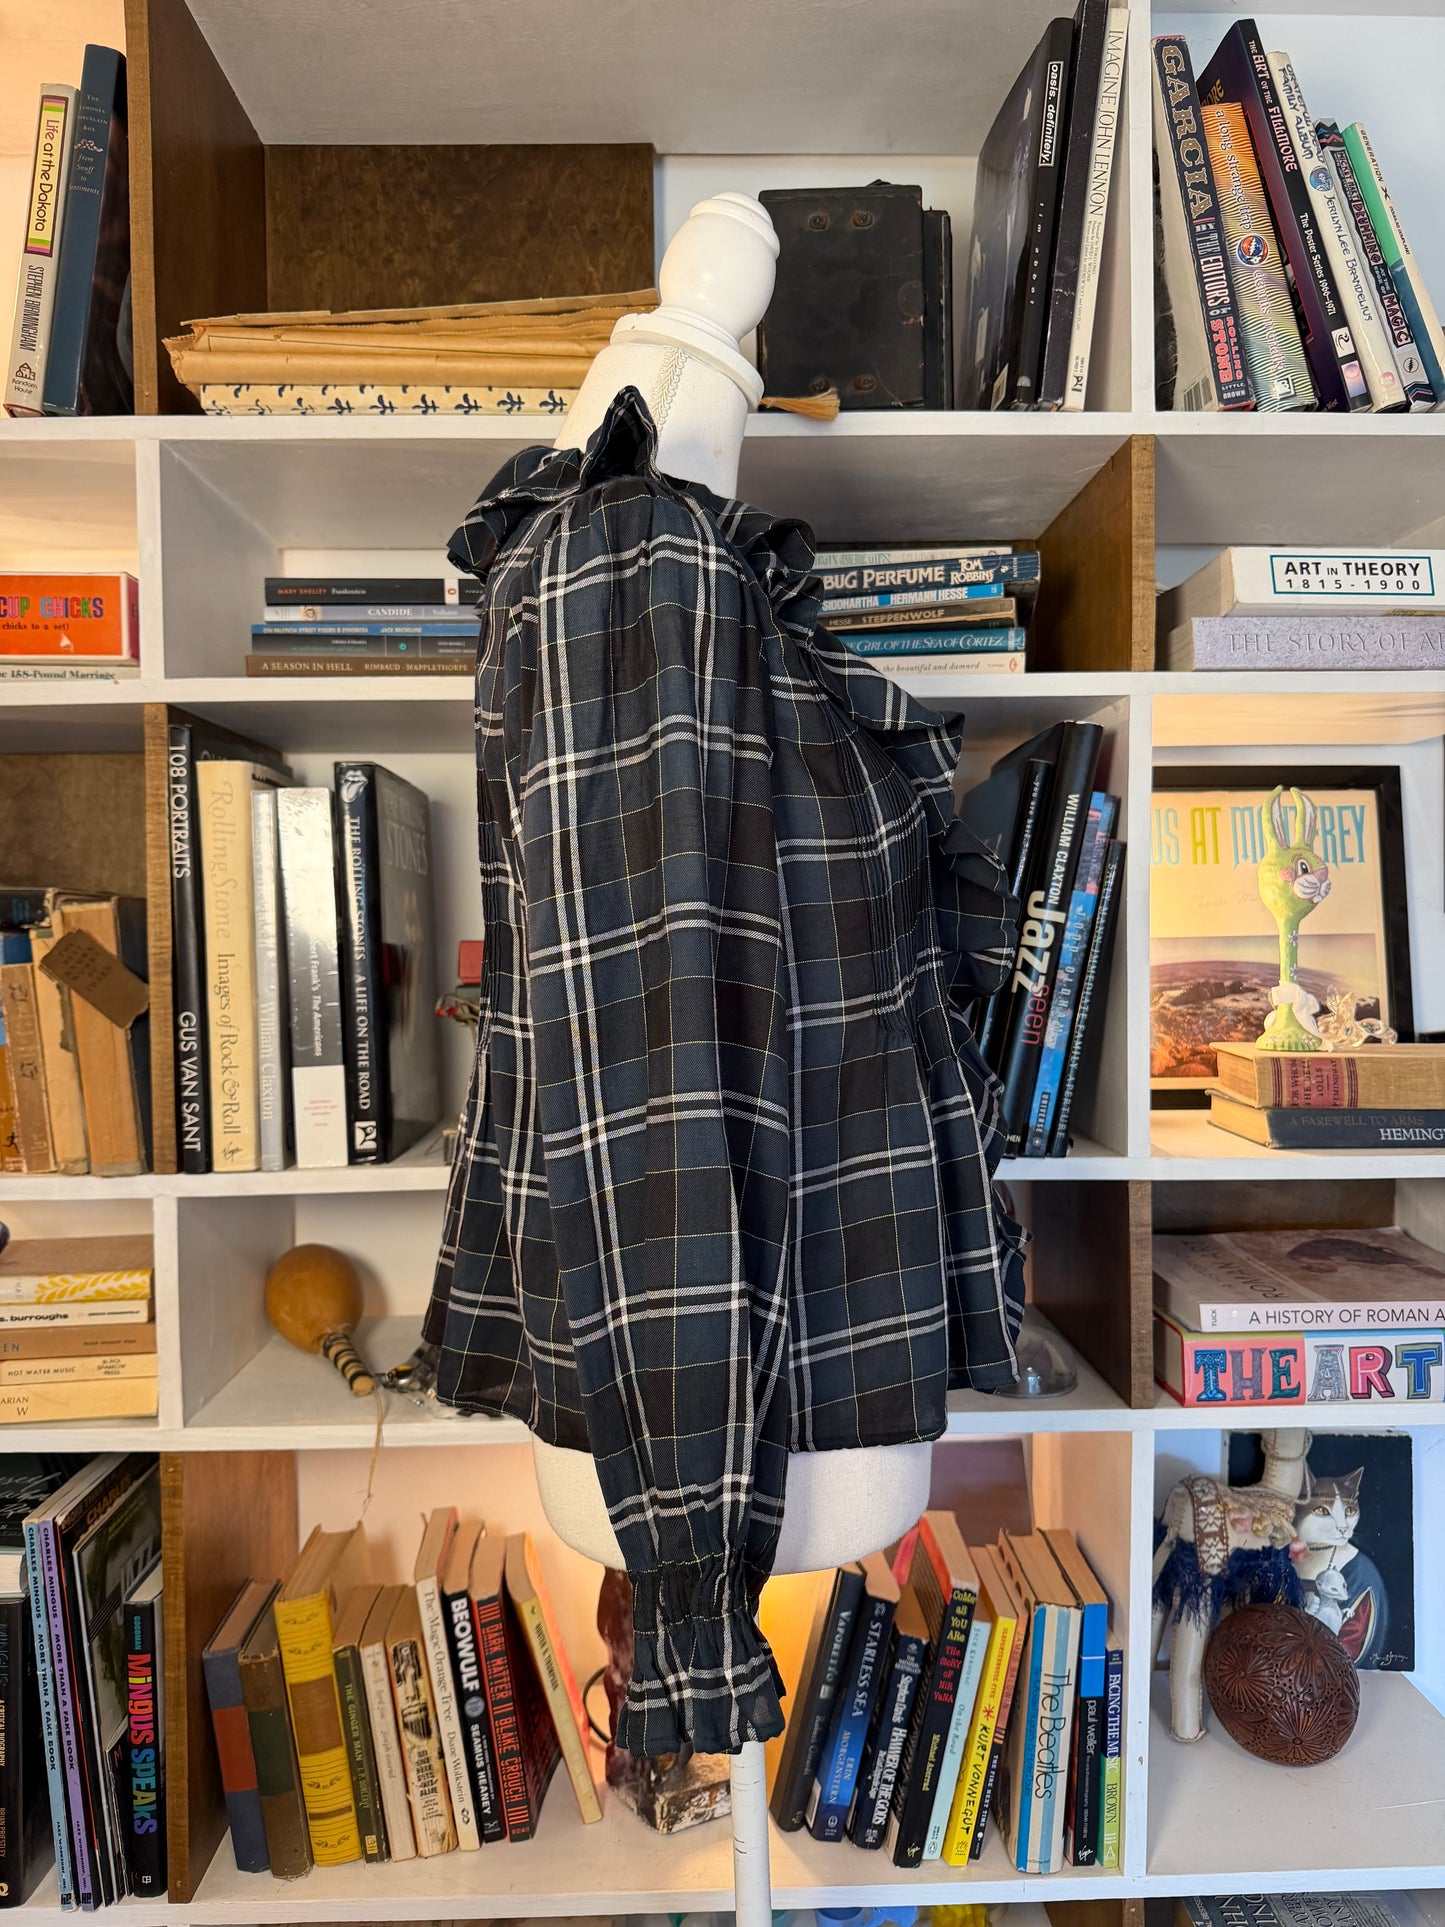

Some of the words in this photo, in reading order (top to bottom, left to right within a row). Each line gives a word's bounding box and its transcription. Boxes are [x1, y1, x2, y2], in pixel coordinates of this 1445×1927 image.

[1101, 30, 1124, 105] IMAGINE
[1252, 54, 1270, 80] ART
[1260, 80, 1269, 91] OF
[1263, 90, 1274, 105] THE
[44, 119, 60, 141] Life
[1097, 105, 1116, 150] JOHN
[1162, 45, 1213, 219] GARCIA
[1295, 116, 1314, 160] ALBUM
[43, 142, 55, 158] at
[1218, 122, 1233, 151] long
[1227, 154, 1245, 205] strange
[1360, 129, 1384, 182] GENERATION
[1381, 186, 1392, 202] X
[40, 160, 56, 181] the
[1089, 153, 1111, 216] LENNON
[34, 183, 54, 232] Dakota
[1195, 223, 1216, 233] BY
[1304, 228, 1318, 254] Poster
[1352, 202, 1382, 264] DRUMMING
[1196, 233, 1221, 256] THE
[25, 264, 45, 300] STEPHEN
[1200, 256, 1230, 307] EDITORS
[19, 300, 41, 352] BIRMINGHAM
[1383, 293, 1410, 343] MAGIC
[1210, 319, 1233, 384] STONE
[1226, 316, 1243, 380] ROLLING
[14, 386, 33, 395] House
[862, 565, 946, 590] PERFUME
[950, 568, 995, 586] ROBBINS
[958, 558, 984, 571] TOM
[1284, 561, 1322, 576] ART
[1326, 567, 1339, 576] IN
[1342, 562, 1421, 577] THEORY
[40, 597, 104, 619] CHICKS
[367, 608, 414, 617] CANDIDE
[821, 595, 879, 612] SIDDHARTHA
[889, 590, 938, 606] HERMANN
[937, 587, 969, 602] HESSE
[2, 622, 28, 630] chicks
[31, 622, 40, 630] to
[861, 609, 946, 624] STEPPENWOLF
[856, 639, 881, 652] GIRL
[958, 633, 1005, 650] CORTEZ
[1226, 633, 1277, 652] THE
[1287, 632, 1374, 652] STORY
[1378, 632, 1412, 652] OF
[68, 670, 116, 680] Marriage
[270, 662, 311, 671] SEASON
[312, 662, 325, 671] IN
[326, 662, 353, 672] HELL
[364, 663, 401, 672] RIMBAUD
[895, 663, 932, 674] beautiful
[932, 662, 948, 671] and
[947, 661, 980, 671] damned
[168, 744, 188, 778] 108
[169, 783, 191, 879] PORTRAITS
[349, 815, 362, 844] THE
[1058, 793, 1081, 848] WILLIAM
[1190, 806, 1222, 866] AT
[350, 848, 366, 909] ROLLING
[1047, 849, 1069, 906] CLAXTON
[352, 911, 368, 961] STONES
[1011, 890, 1067, 994] Jazz
[213, 953, 236, 1015] Images
[353, 973, 368, 984] A
[354, 986, 368, 1014] LIFE
[1020, 984, 1050, 1046] seen
[178, 1010, 198, 1053] GUS
[216, 1015, 241, 1031] of
[259, 1001, 281, 1059] William
[356, 1016, 370, 1039] ON
[220, 1034, 239, 1076] Rock
[356, 1040, 370, 1068] THE
[1070, 1022, 1086, 1070] FAMILY
[179, 1056, 201, 1097] VAN
[1290, 1057, 1300, 1087] WHOM
[1302, 1057, 1312, 1086] BELL
[1315, 1066, 1323, 1097] TOLLS
[1331, 1059, 1340, 1107] HEMINGWAY
[262, 1062, 278, 1121] Claxton
[357, 1070, 371, 1111] ROAD
[1290, 1087, 1300, 1108] FOR
[1302, 1087, 1312, 1108] THE
[222, 1102, 242, 1135] Roll
[1035, 1093, 1050, 1133] UNIVERSE
[1056, 1076, 1076, 1140] APERTURE
[1301, 1115, 1366, 1127] FAREWELL
[1368, 1115, 1386, 1126] TO
[1390, 1115, 1425, 1127] ARMS
[181, 1102, 201, 1152] SANT
[10, 1311, 70, 1323] burroughs
[1210, 1308, 1218, 1328] TUCK
[1248, 1310, 1262, 1325] A
[1265, 1308, 1336, 1325] HISTORY
[1338, 1308, 1362, 1324] OF
[1366, 1307, 1431, 1323] ROMAN
[26, 1367, 51, 1376] WATER
[53, 1366, 77, 1374] MUSIC
[1193, 1347, 1302, 1403] THE
[1306, 1341, 1443, 1402] ART
[27, 1527, 38, 1573] CHARLES
[42, 1527, 53, 1573] CHARLES
[31, 1575, 42, 1620] MINGUS
[48, 1576, 58, 1619] MINGUS
[423, 1587, 436, 1611] The
[427, 1612, 441, 1650] Magic
[449, 1596, 480, 1692] BEOWULF
[485, 1623, 505, 1653] DARK
[37, 1634, 46, 1665] MORE
[54, 1633, 63, 1664] MORE
[856, 1620, 883, 1689] STARLESS
[40, 1667, 50, 1697] THAN
[58, 1667, 67, 1697] THAN
[434, 1650, 448, 1692] Orange
[494, 1655, 514, 1701] MATTER
[44, 1700, 50, 1708] A
[62, 1700, 68, 1708] A
[851, 1690, 869, 1717] SEA
[1041, 1668, 1072, 1713] The
[1107, 1673, 1121, 1716] FACING
[44, 1710, 53, 1737] FAKE
[63, 1710, 71, 1737] FAKE
[348, 1703, 360, 1738] GINGER
[441, 1695, 453, 1722] Tree
[1086, 1699, 1098, 1723] paul
[497, 1715, 520, 1754] BLAKE
[977, 1723, 991, 1762] KURT
[1085, 1721, 1099, 1756] weller
[1107, 1715, 1121, 1741] THE
[48, 1740, 56, 1771] BOOK
[66, 1740, 75, 1770] BOOK
[353, 1740, 363, 1762] MAN
[447, 1731, 457, 1758] Diane
[470, 1722, 485, 1769] SEAMUS
[1034, 1715, 1067, 1799] Beatles
[1106, 1739, 1121, 1774] MUSIC
[828, 1729, 852, 1804] MORGENSTERN
[843, 1757, 856, 1781] ERIN
[991, 1754, 999, 1770] THE
[451, 1758, 465, 1803] Wolkstein
[477, 1771, 492, 1815] HEANEY
[503, 1756, 527, 1803] CROUCH
[987, 1770, 996, 1787] FIRE
[872, 1800, 890, 1826] GODS
[960, 1762, 983, 1836] VONNEGUT
[983, 1788, 992, 1808] NEXT
[1105, 1782, 1118, 1824] BROWN
[979, 1809, 988, 1828] TIME
